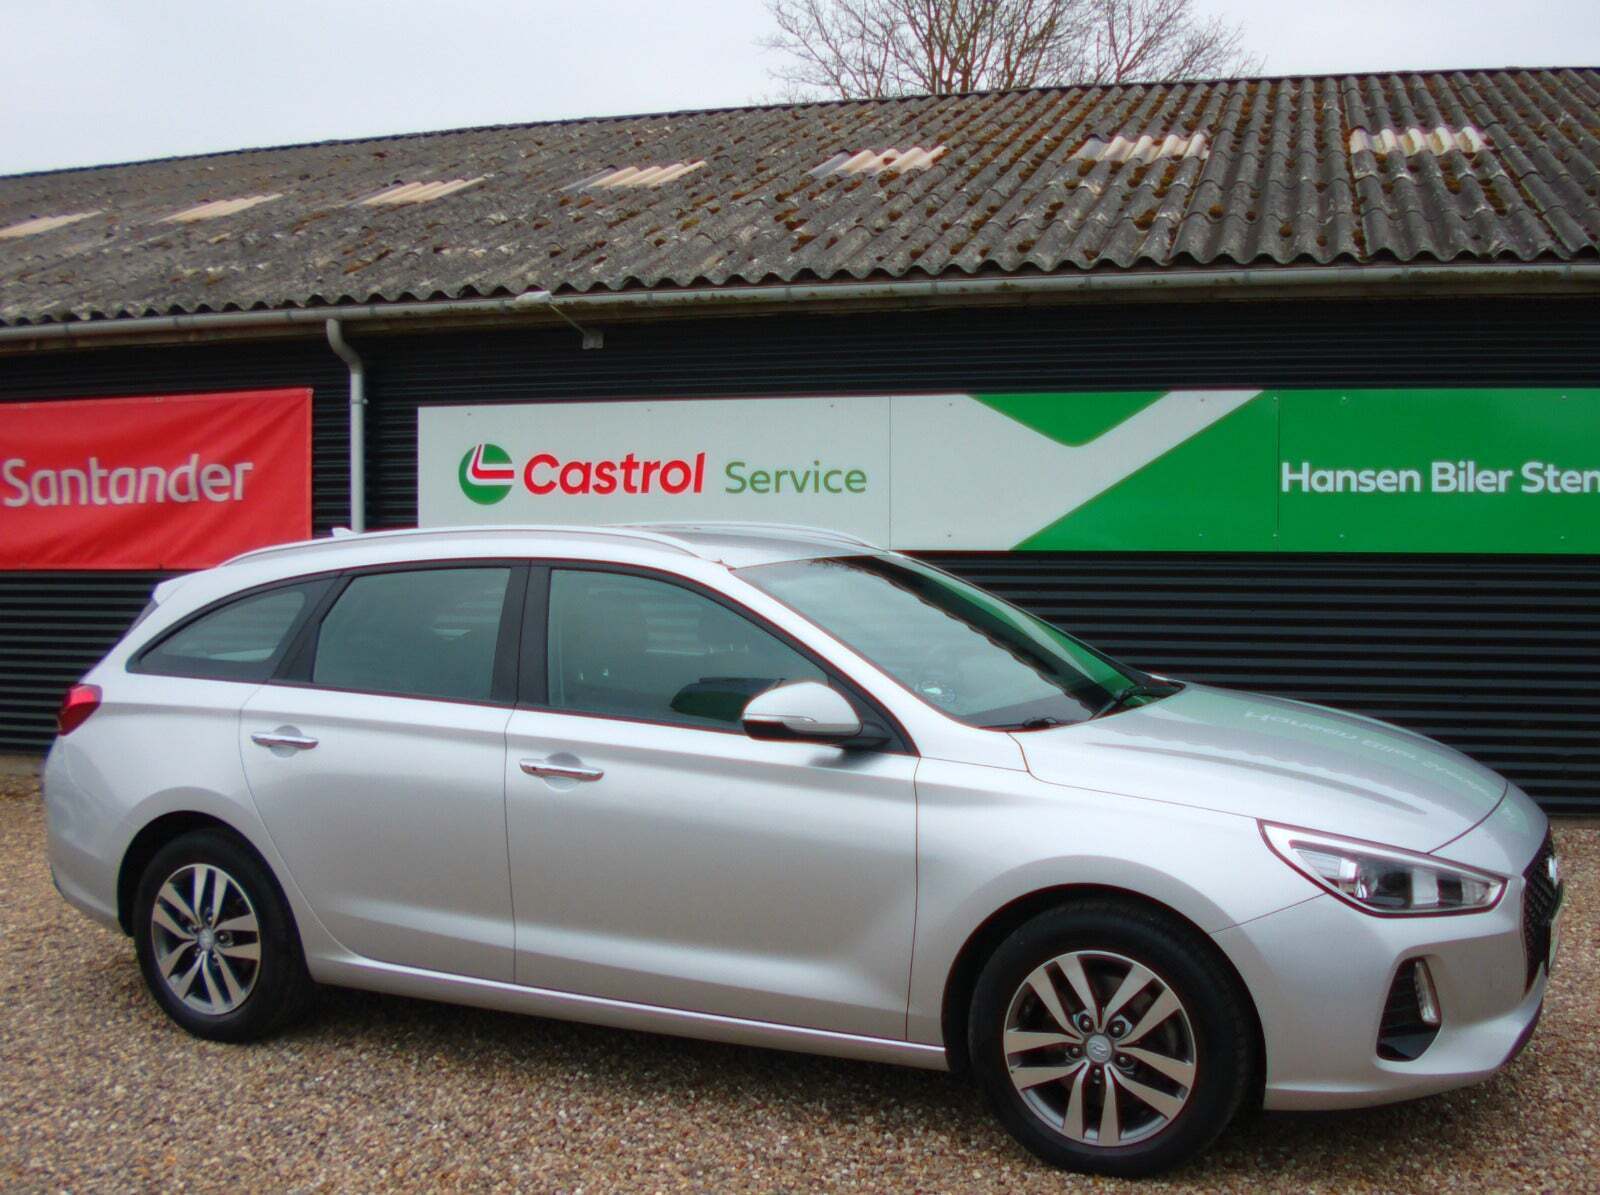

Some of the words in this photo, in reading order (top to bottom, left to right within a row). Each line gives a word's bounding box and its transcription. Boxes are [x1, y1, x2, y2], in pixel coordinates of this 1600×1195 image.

[2, 453, 254, 507] Santander
[524, 452, 706, 495] Castrol
[724, 460, 867, 494] Service
[1281, 461, 1422, 493] Hansen
[1431, 460, 1513, 493] Biler
